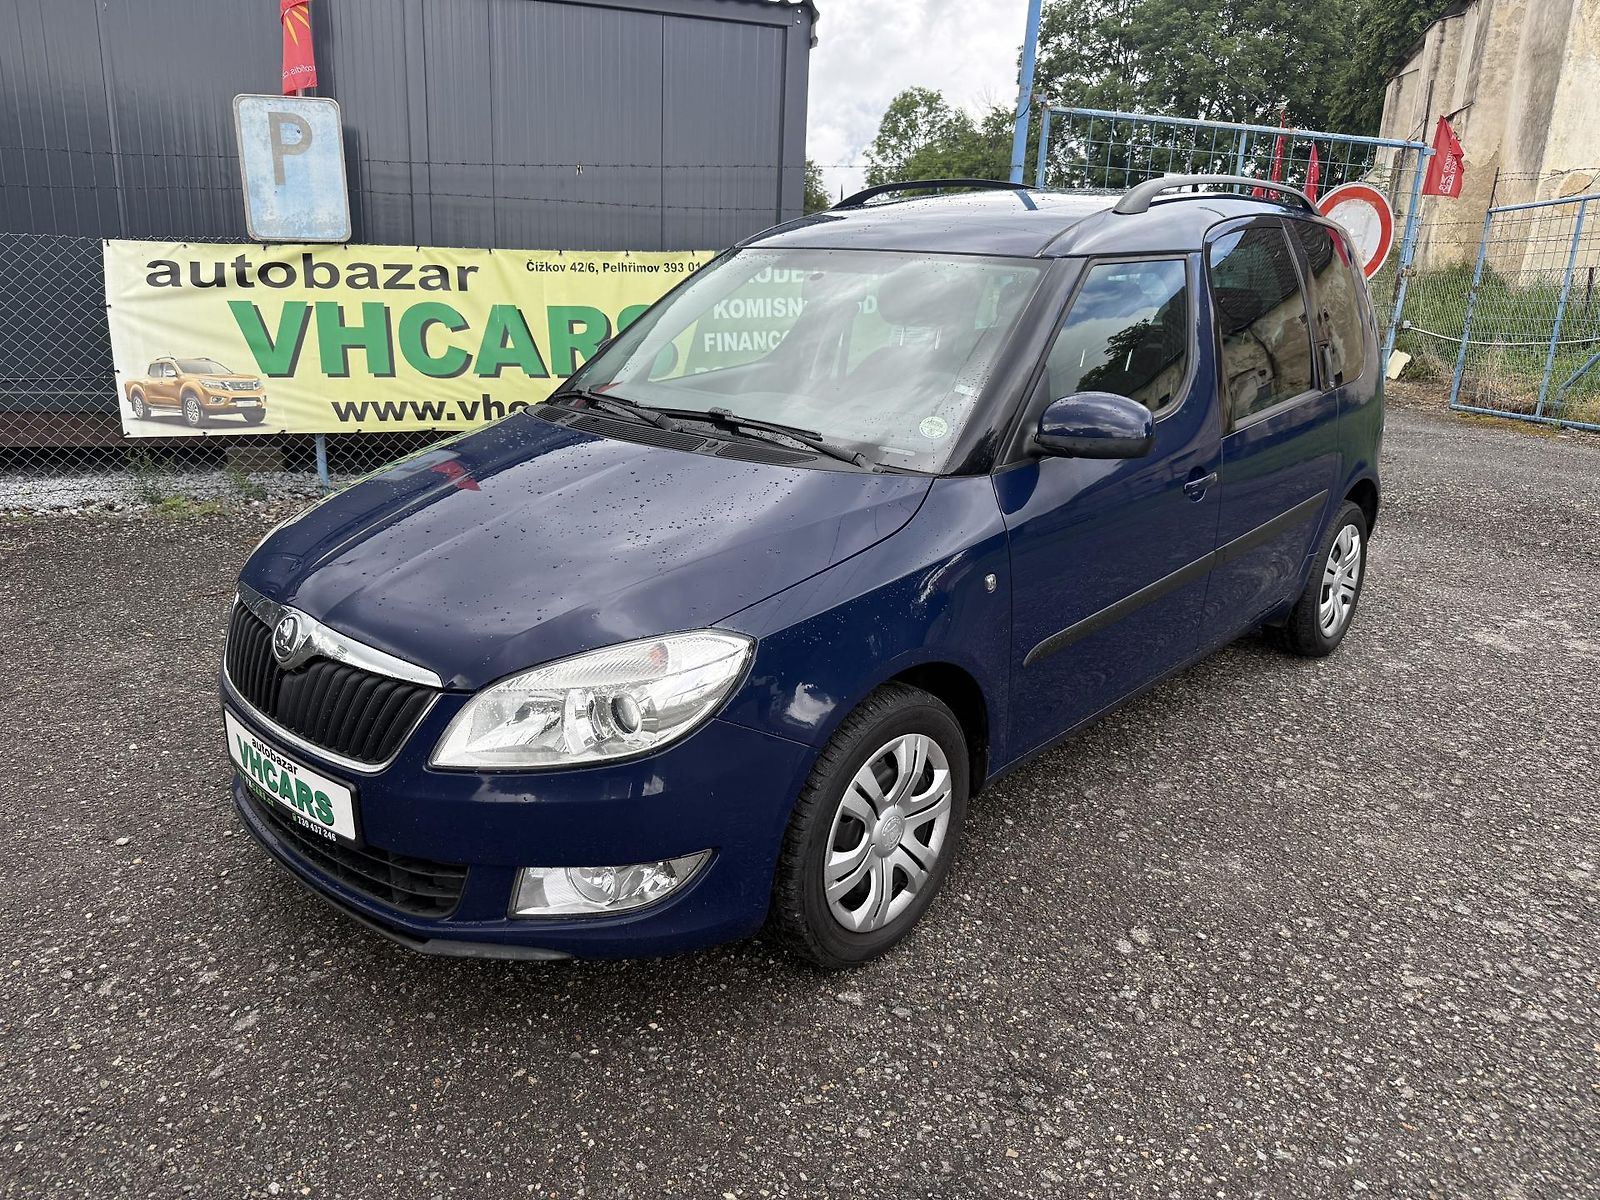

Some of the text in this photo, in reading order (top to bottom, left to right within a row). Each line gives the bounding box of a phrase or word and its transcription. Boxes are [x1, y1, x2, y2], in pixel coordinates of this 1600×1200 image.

[267, 111, 313, 186] P
[145, 253, 479, 292] autobazar
[526, 259, 566, 273] Čížkov
[569, 262, 599, 275] 42/6,
[602, 261, 660, 273] Pelhřimov
[663, 262, 684, 273] 393
[713, 297, 808, 320] KOMISN
[704, 330, 790, 352] FINANC
[251, 738, 298, 775] autobazar
[236, 733, 335, 826] VHCARS
